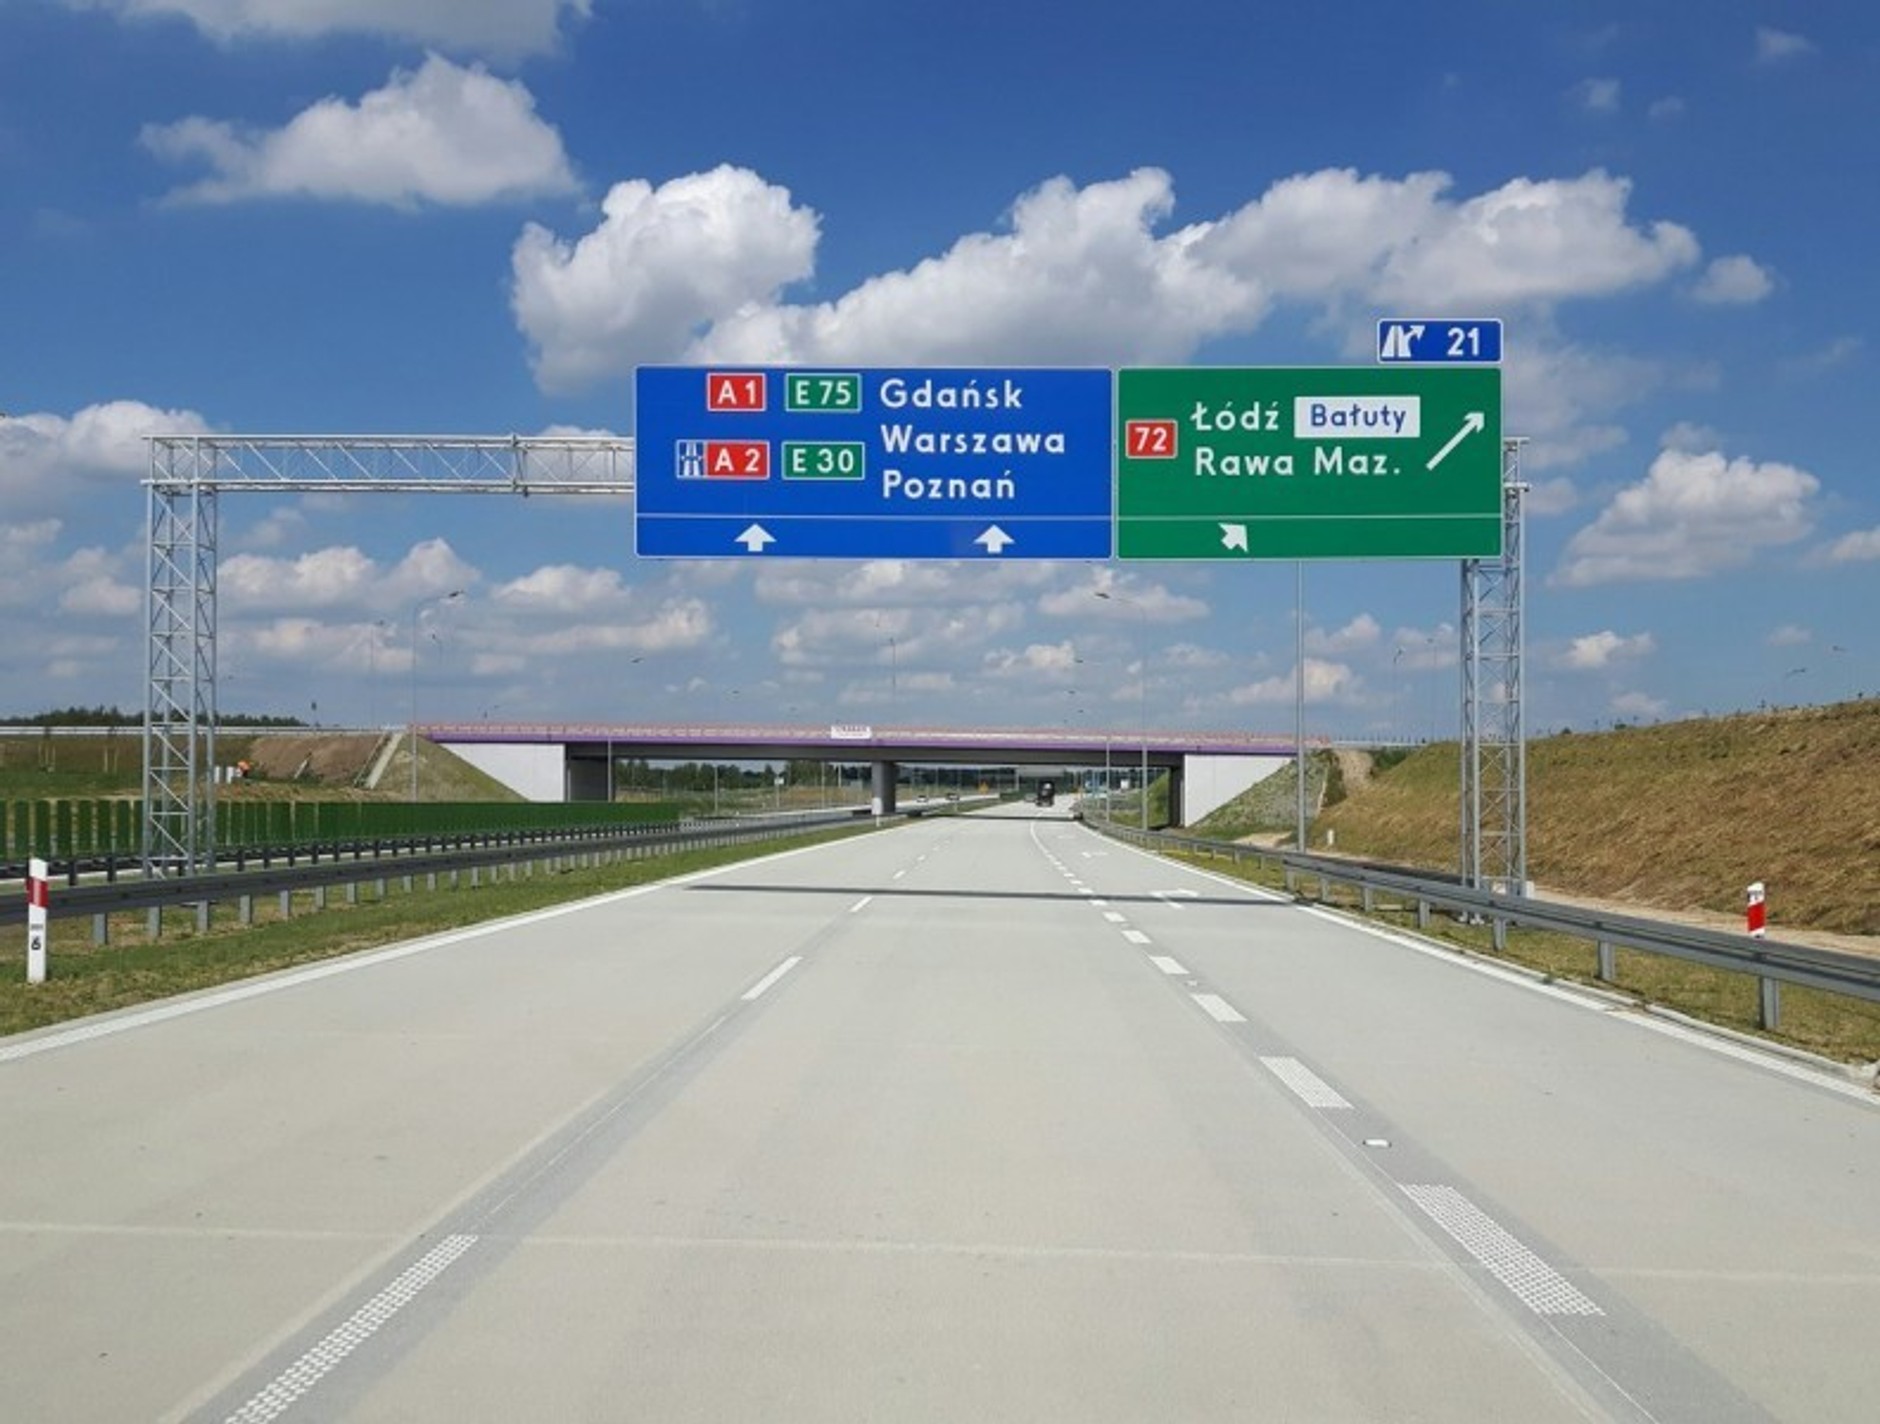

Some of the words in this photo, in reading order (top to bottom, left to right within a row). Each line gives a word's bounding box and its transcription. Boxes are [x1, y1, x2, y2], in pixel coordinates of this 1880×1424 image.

[1447, 327, 1479, 357] 21
[880, 378, 1022, 409] Gdańsk
[1190, 401, 1279, 431] Łódź
[1310, 403, 1407, 434] Bałuty
[880, 424, 1065, 454] Warszawa
[1135, 426, 1167, 452] 72
[1195, 446, 1294, 476] Rawa
[1314, 446, 1400, 475] Maz.
[882, 469, 1015, 499] Poznań
